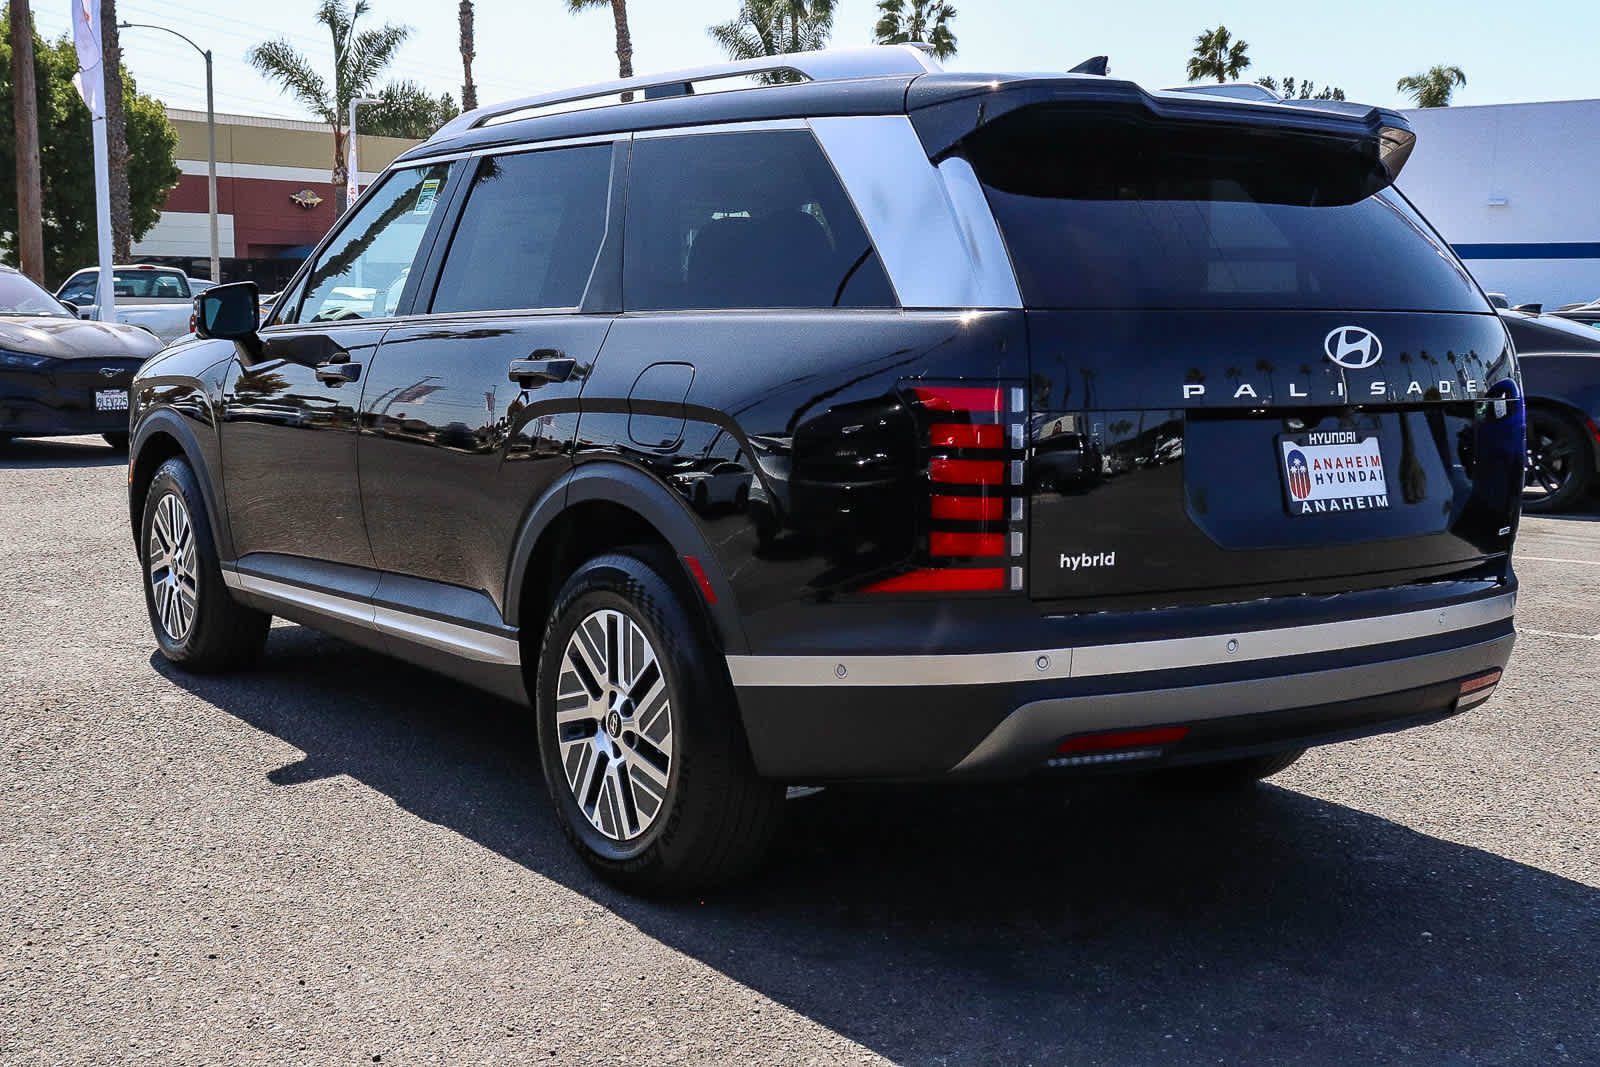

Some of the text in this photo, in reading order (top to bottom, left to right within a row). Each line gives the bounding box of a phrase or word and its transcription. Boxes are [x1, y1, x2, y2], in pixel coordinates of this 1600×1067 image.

[1182, 379, 1477, 399] PALISADE
[1308, 431, 1356, 445] HYUNDAI
[1314, 455, 1380, 471] ANAHEIM
[1315, 470, 1383, 485] HYUNDAI
[1301, 495, 1389, 514] ANAHEIM
[1060, 551, 1116, 571] hybrid
